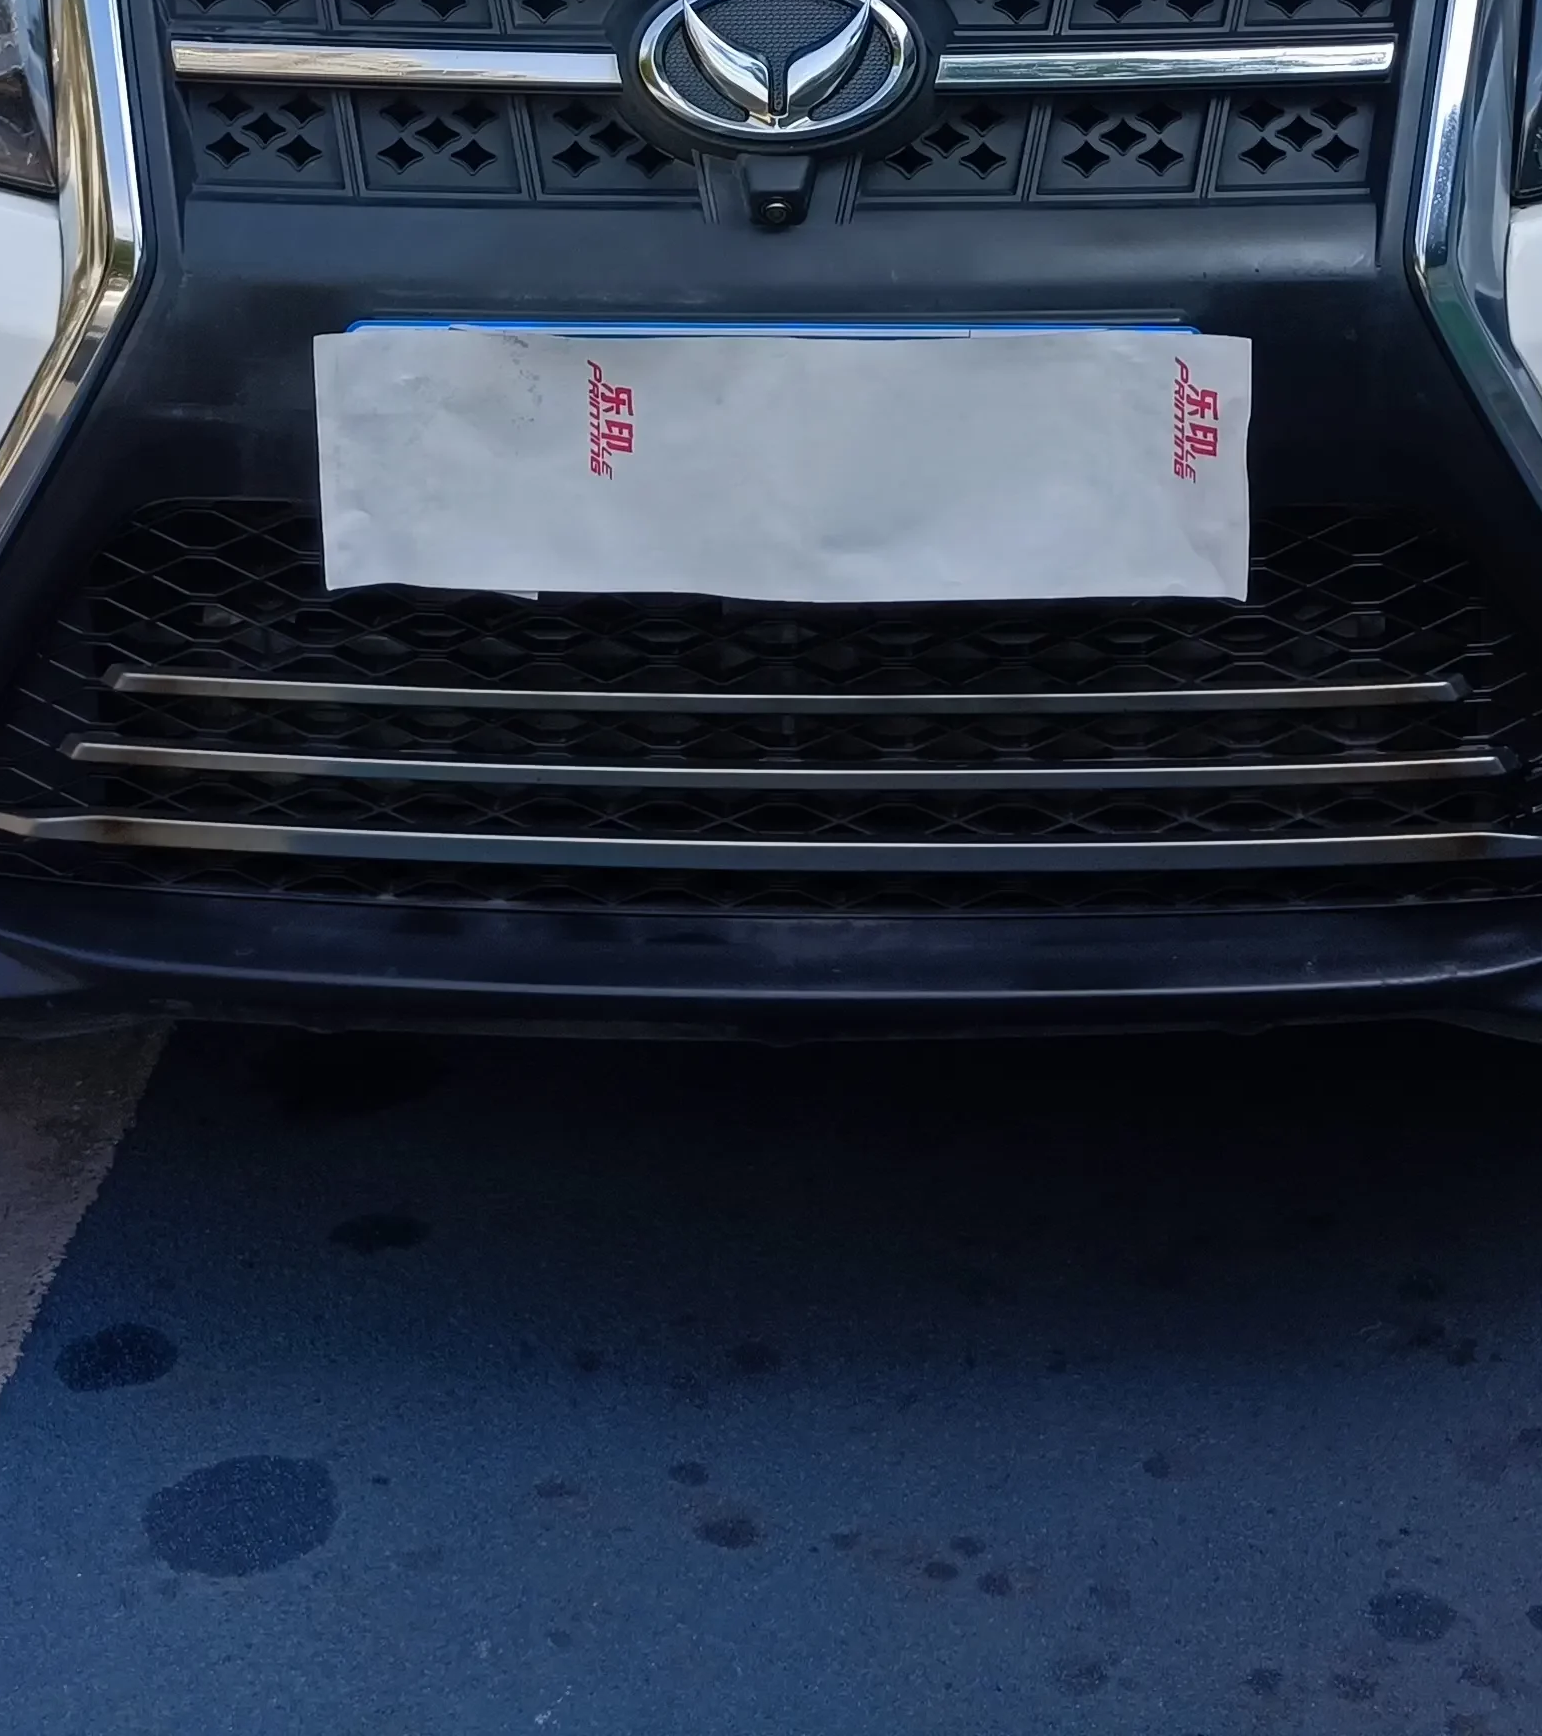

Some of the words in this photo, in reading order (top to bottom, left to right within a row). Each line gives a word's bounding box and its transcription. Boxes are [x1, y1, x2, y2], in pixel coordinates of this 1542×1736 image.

[587, 360, 602, 476] PRINTING
[601, 383, 634, 453] 乐印
[1174, 357, 1189, 479] PRINTING
[1186, 384, 1219, 457] 乐印
[602, 446, 613, 480] LE
[1185, 449, 1196, 484] LE
